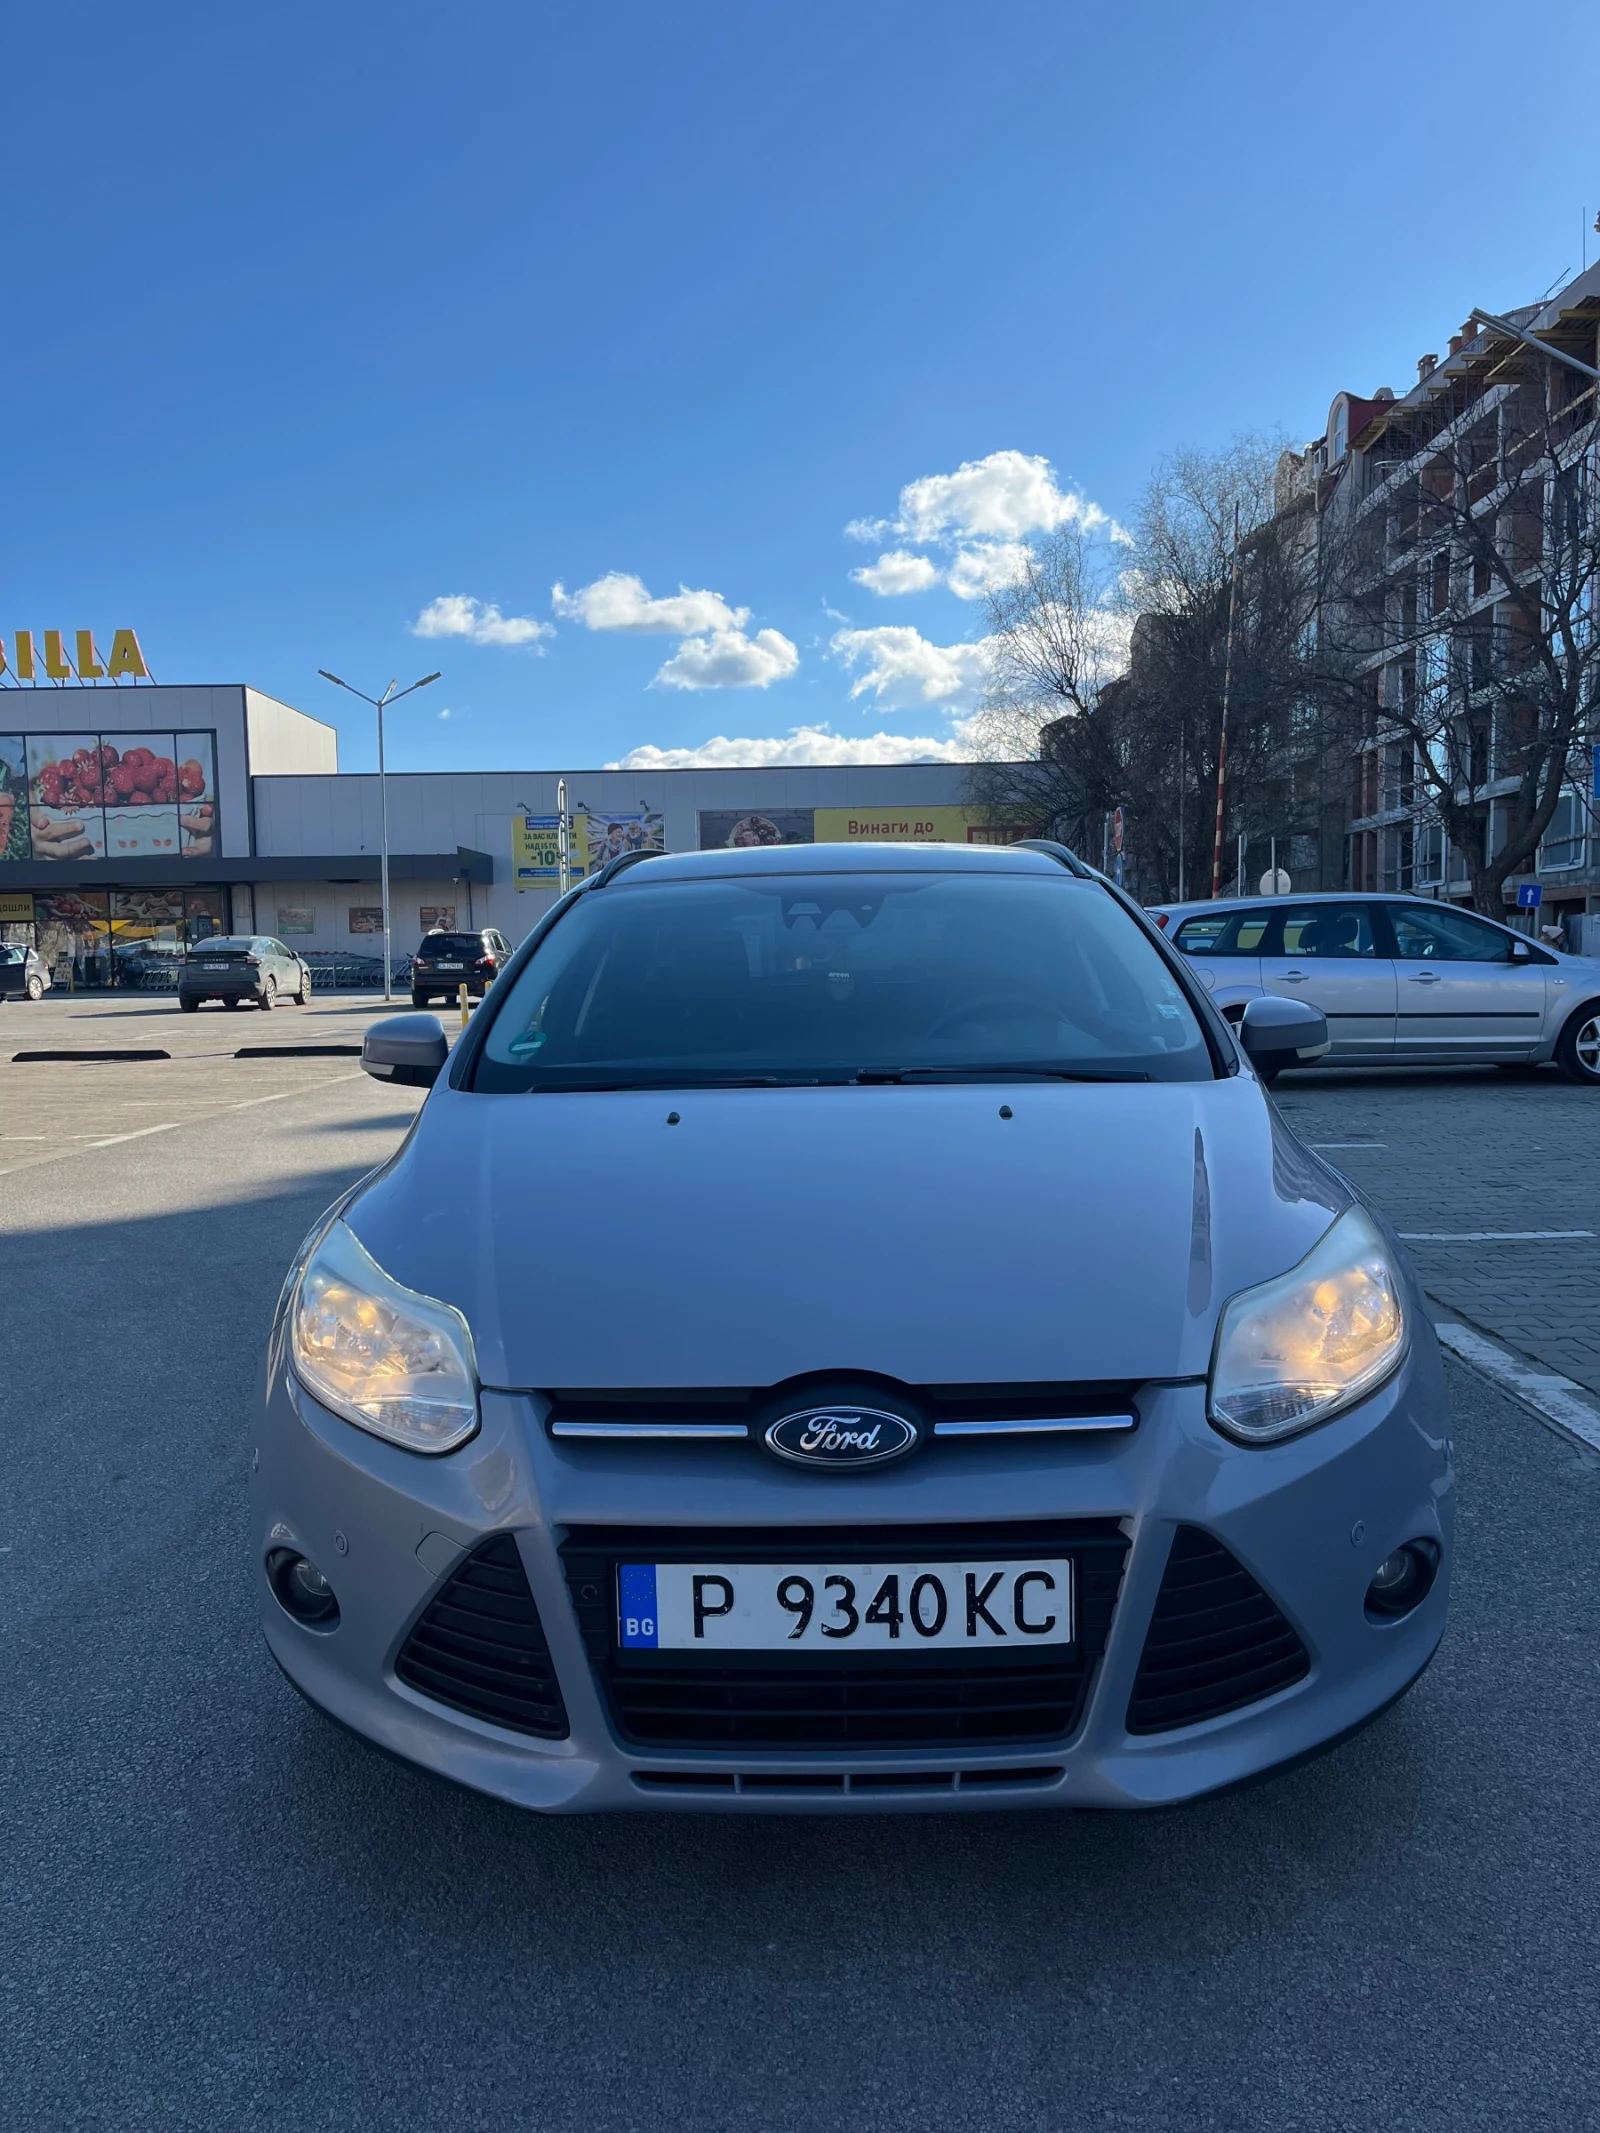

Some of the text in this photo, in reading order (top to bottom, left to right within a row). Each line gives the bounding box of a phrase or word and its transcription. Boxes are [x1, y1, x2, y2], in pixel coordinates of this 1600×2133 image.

[533, 832, 546, 840] ВАС
[848, 820, 934, 835] Винаги до
[525, 842, 541, 851] НАД
[799, 1416, 882, 1451] Ford
[691, 1570, 1056, 1639] P 9340 KC
[626, 1617, 655, 1636] BG
